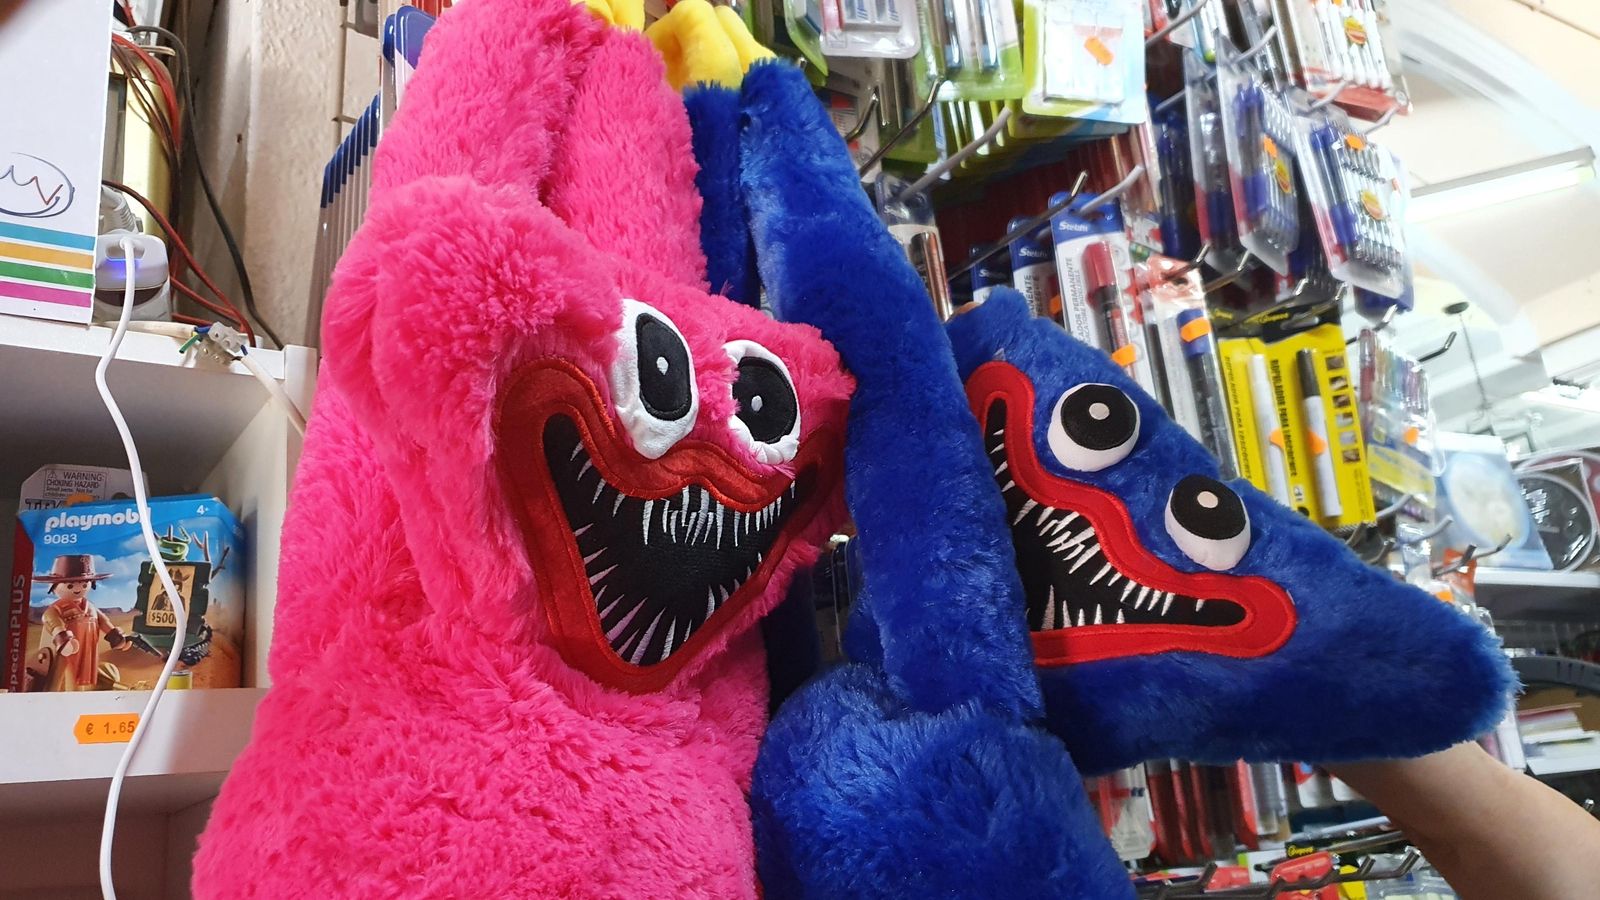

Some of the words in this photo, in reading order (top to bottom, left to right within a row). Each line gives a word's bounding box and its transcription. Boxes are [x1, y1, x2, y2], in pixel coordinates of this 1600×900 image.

[45, 507, 151, 533] playmobl
[43, 534, 78, 545] 9083
[151, 612, 177, 624] $500
[103, 720, 135, 735] 1.65
